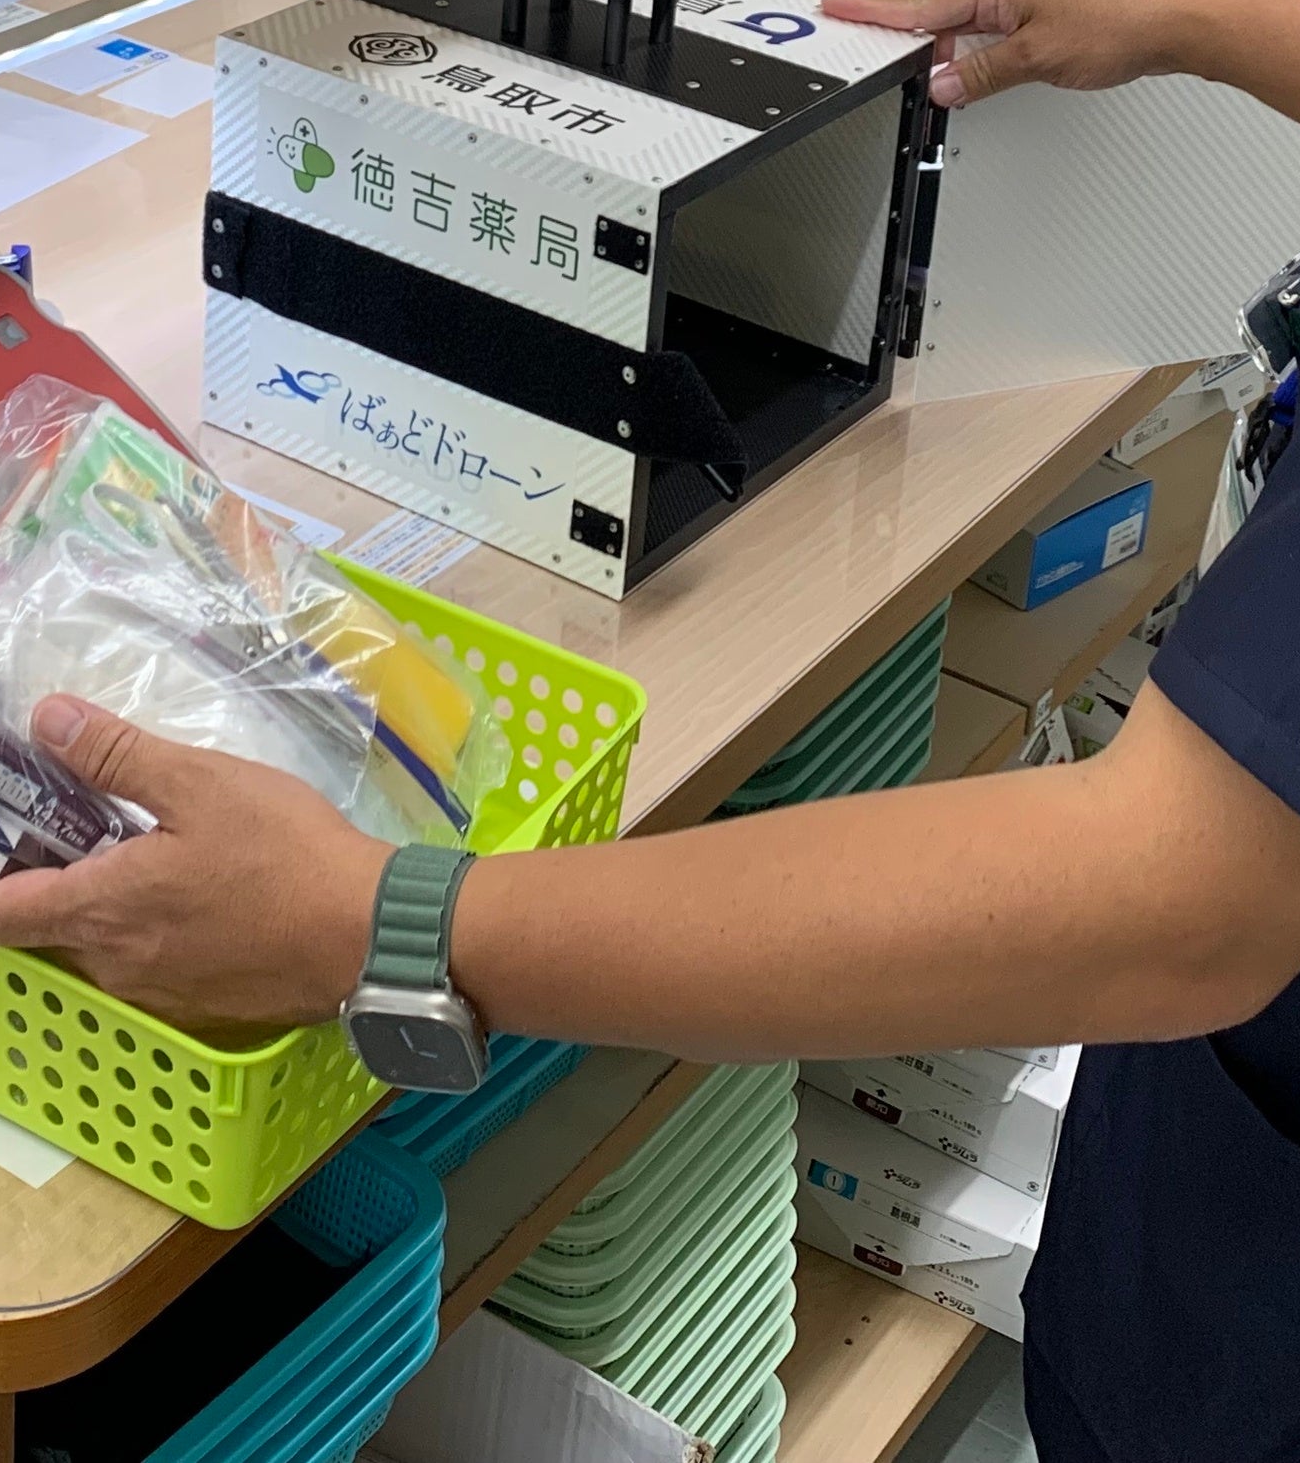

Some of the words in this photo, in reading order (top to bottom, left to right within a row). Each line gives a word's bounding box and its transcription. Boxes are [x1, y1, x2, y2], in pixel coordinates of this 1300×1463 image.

[421, 63, 628, 138] 鳥取市
[350, 147, 581, 282] 徳吉薬局
[340, 387, 567, 501] ばぁどドローン
[951, 1141, 979, 1164] ツムラ
[896, 1173, 922, 1191] ツムラ
[890, 1205, 922, 1230] 葛根湯
[948, 1297, 977, 1317] ツムラ
